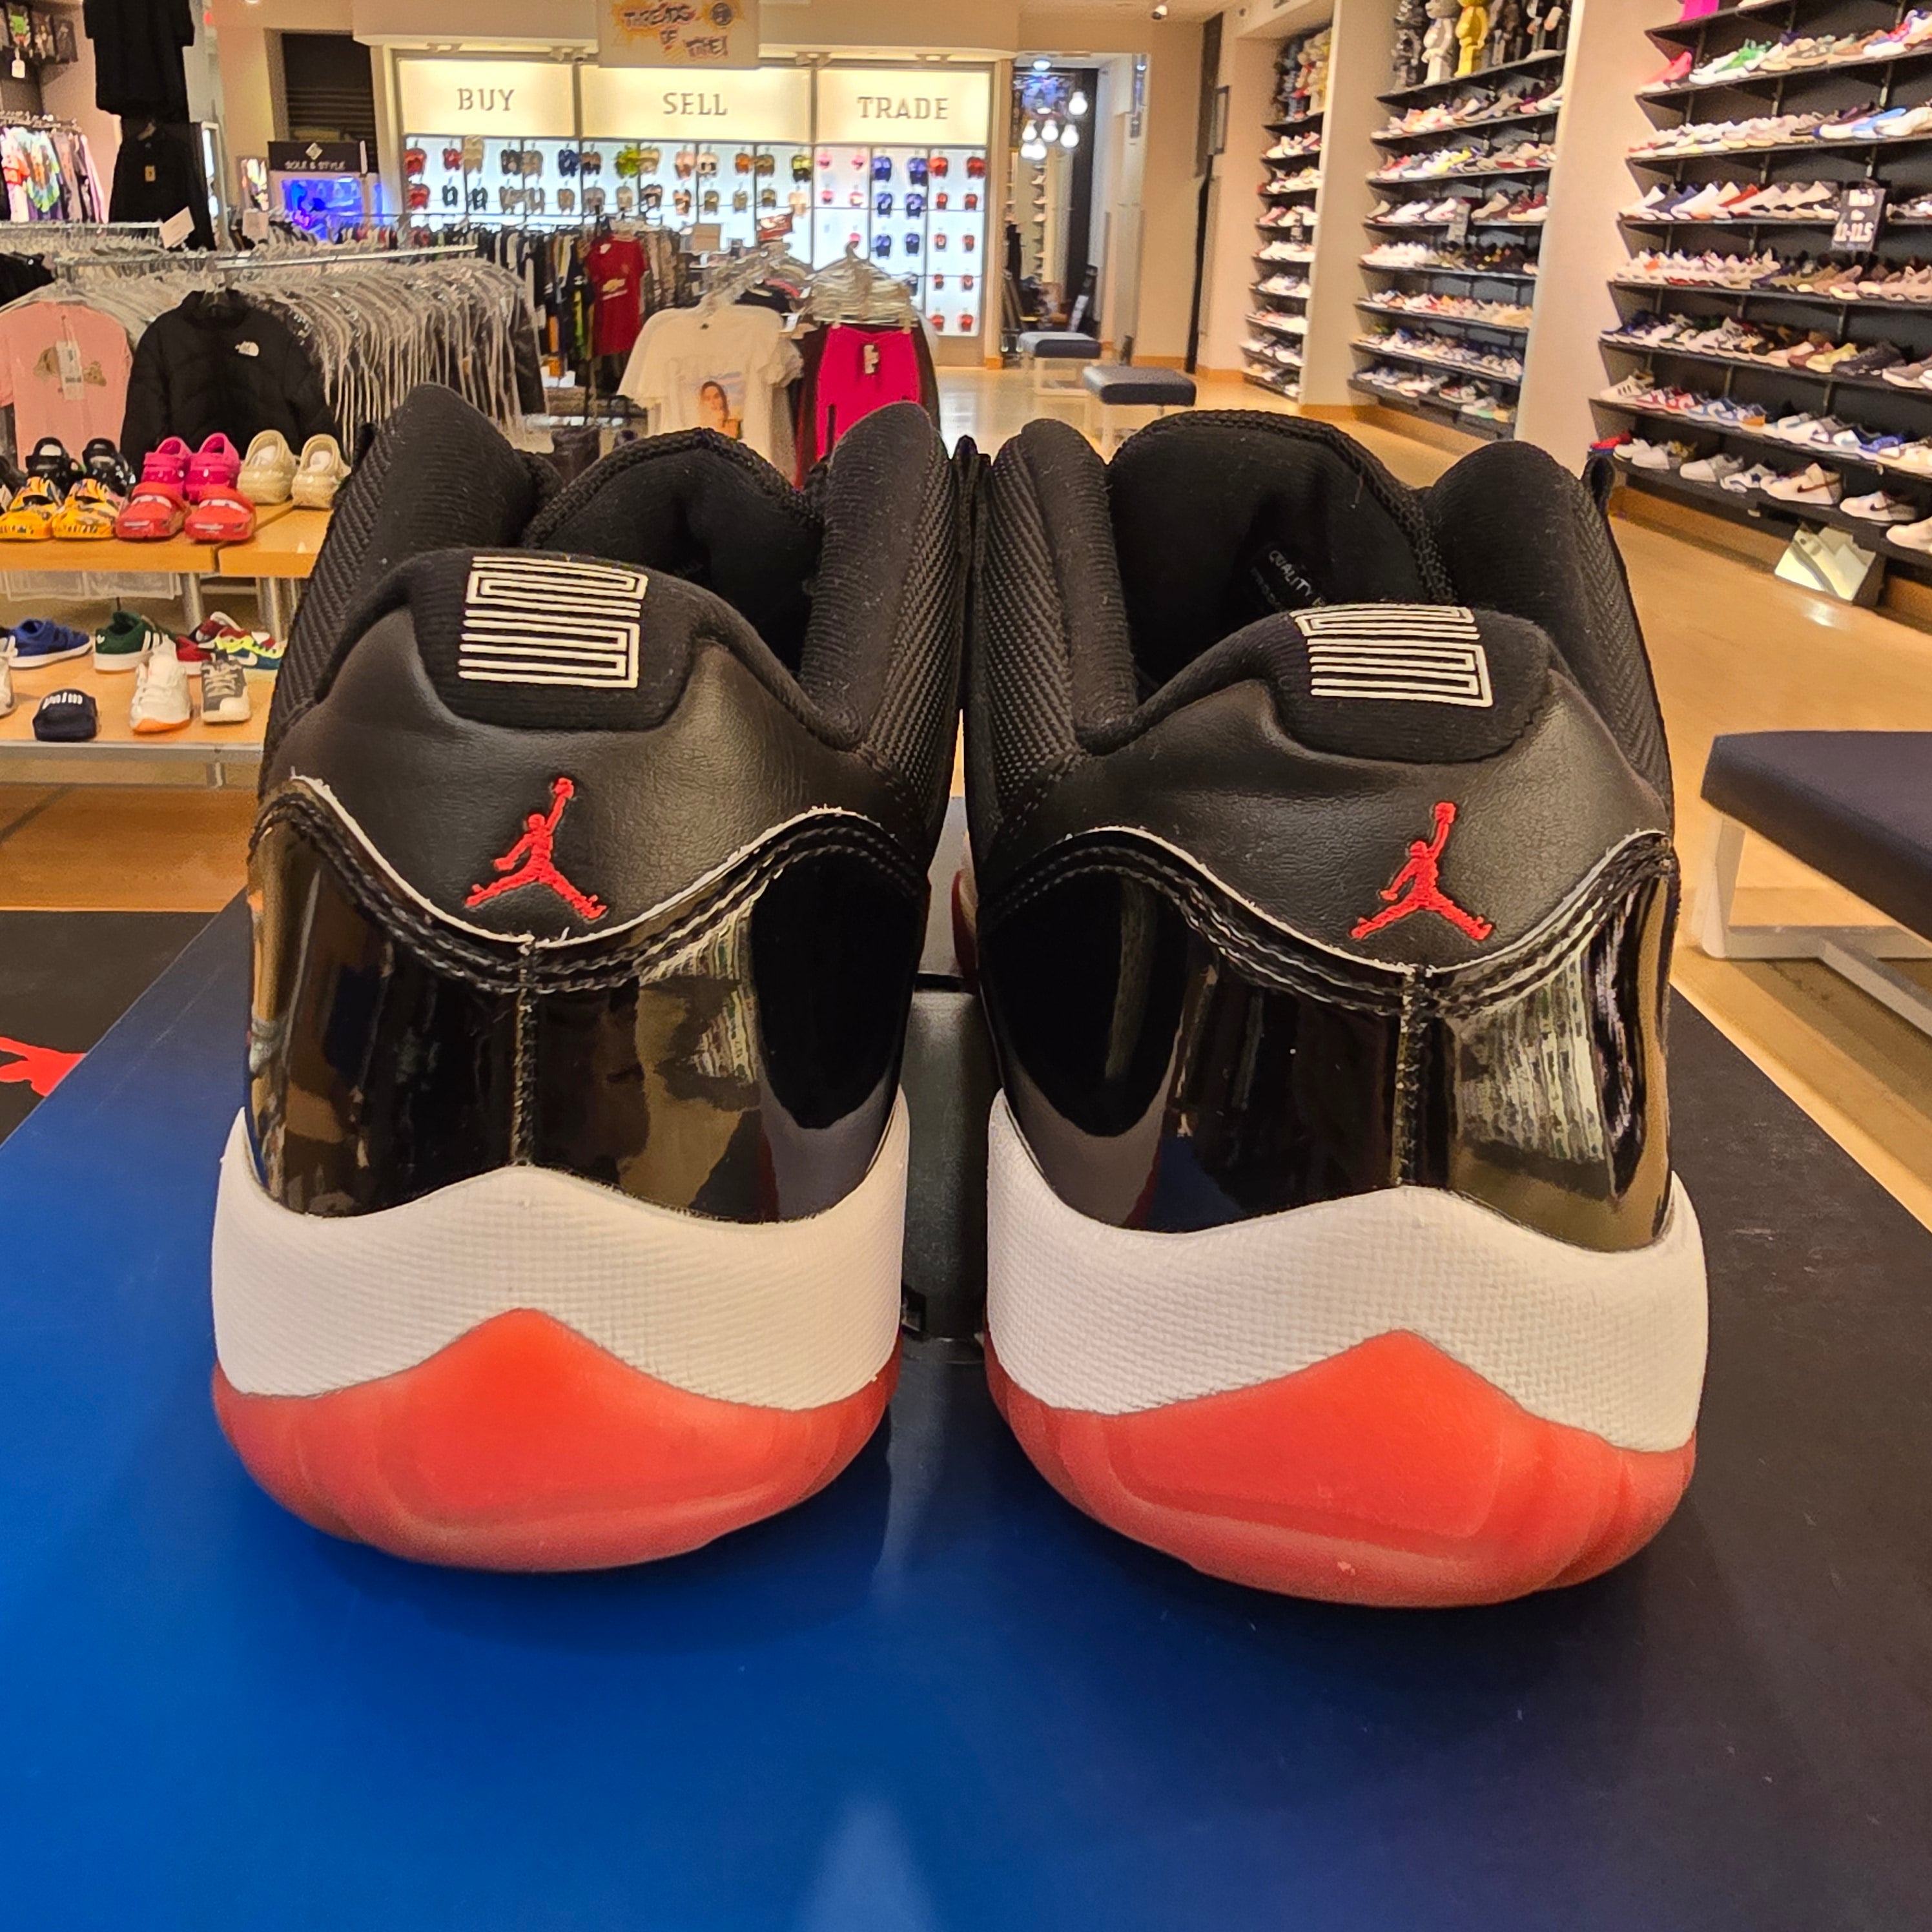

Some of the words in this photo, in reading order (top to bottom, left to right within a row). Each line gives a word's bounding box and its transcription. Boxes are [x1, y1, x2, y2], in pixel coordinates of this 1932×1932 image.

[457, 88, 515, 111] BUY
[663, 92, 728, 116] SELL
[857, 96, 949, 119] TRADE
